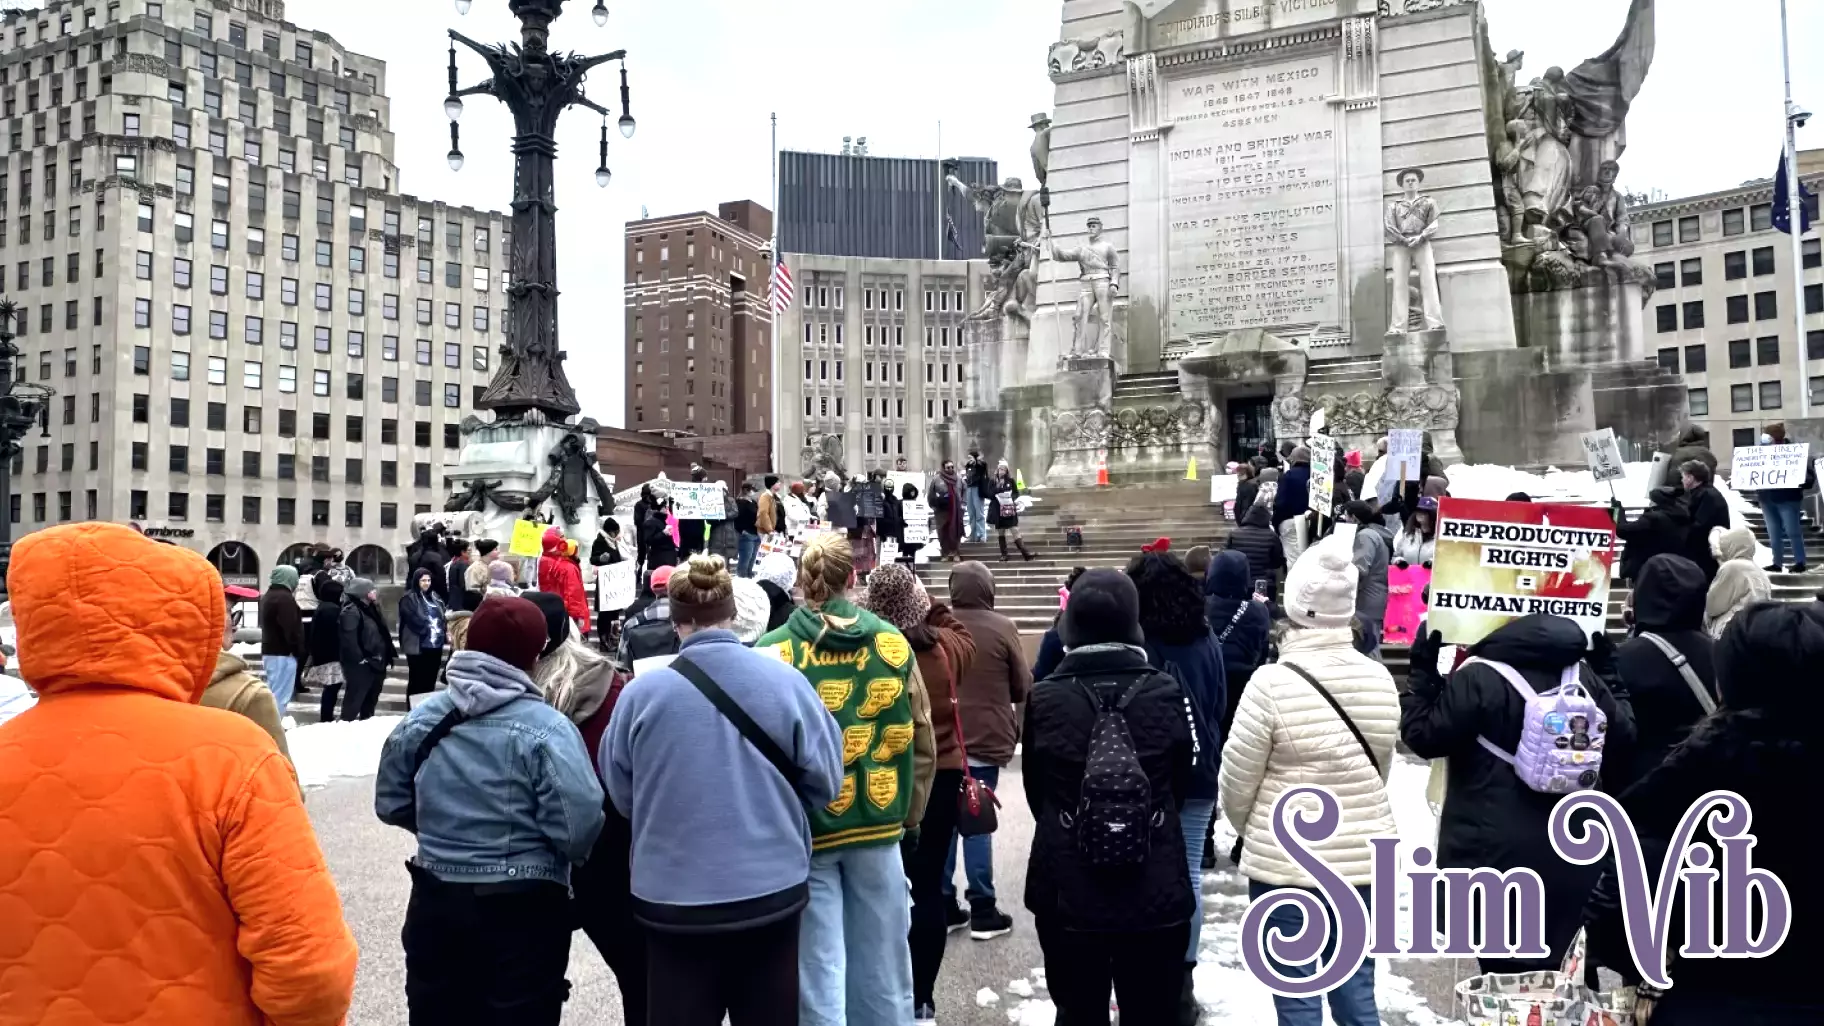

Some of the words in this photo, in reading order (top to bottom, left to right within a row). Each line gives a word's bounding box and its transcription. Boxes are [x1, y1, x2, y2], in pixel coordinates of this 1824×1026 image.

[1182, 84, 1215, 97] WAR
[1222, 77, 1259, 91] WITH
[1266, 67, 1318, 84] MEXICO
[1170, 146, 1212, 161] INDIAN
[1216, 143, 1241, 155] AND
[1247, 134, 1299, 150] BRITISH
[1304, 130, 1333, 141] WAR
[1172, 220, 1198, 232] WAR
[1253, 204, 1333, 222] REVOLUTION
[1205, 232, 1299, 250] VINCENNES
[1227, 269, 1276, 282] BORDER
[1282, 263, 1337, 277] SERVICE
[1749, 470, 1787, 486] RICH
[143, 526, 195, 538] ambrose
[1443, 522, 1611, 547] REPRODUCTIVE
[1487, 548, 1568, 568] RIGHTS
[1435, 592, 1523, 613] HUMAN
[1528, 601, 1602, 617] RIGHTS
